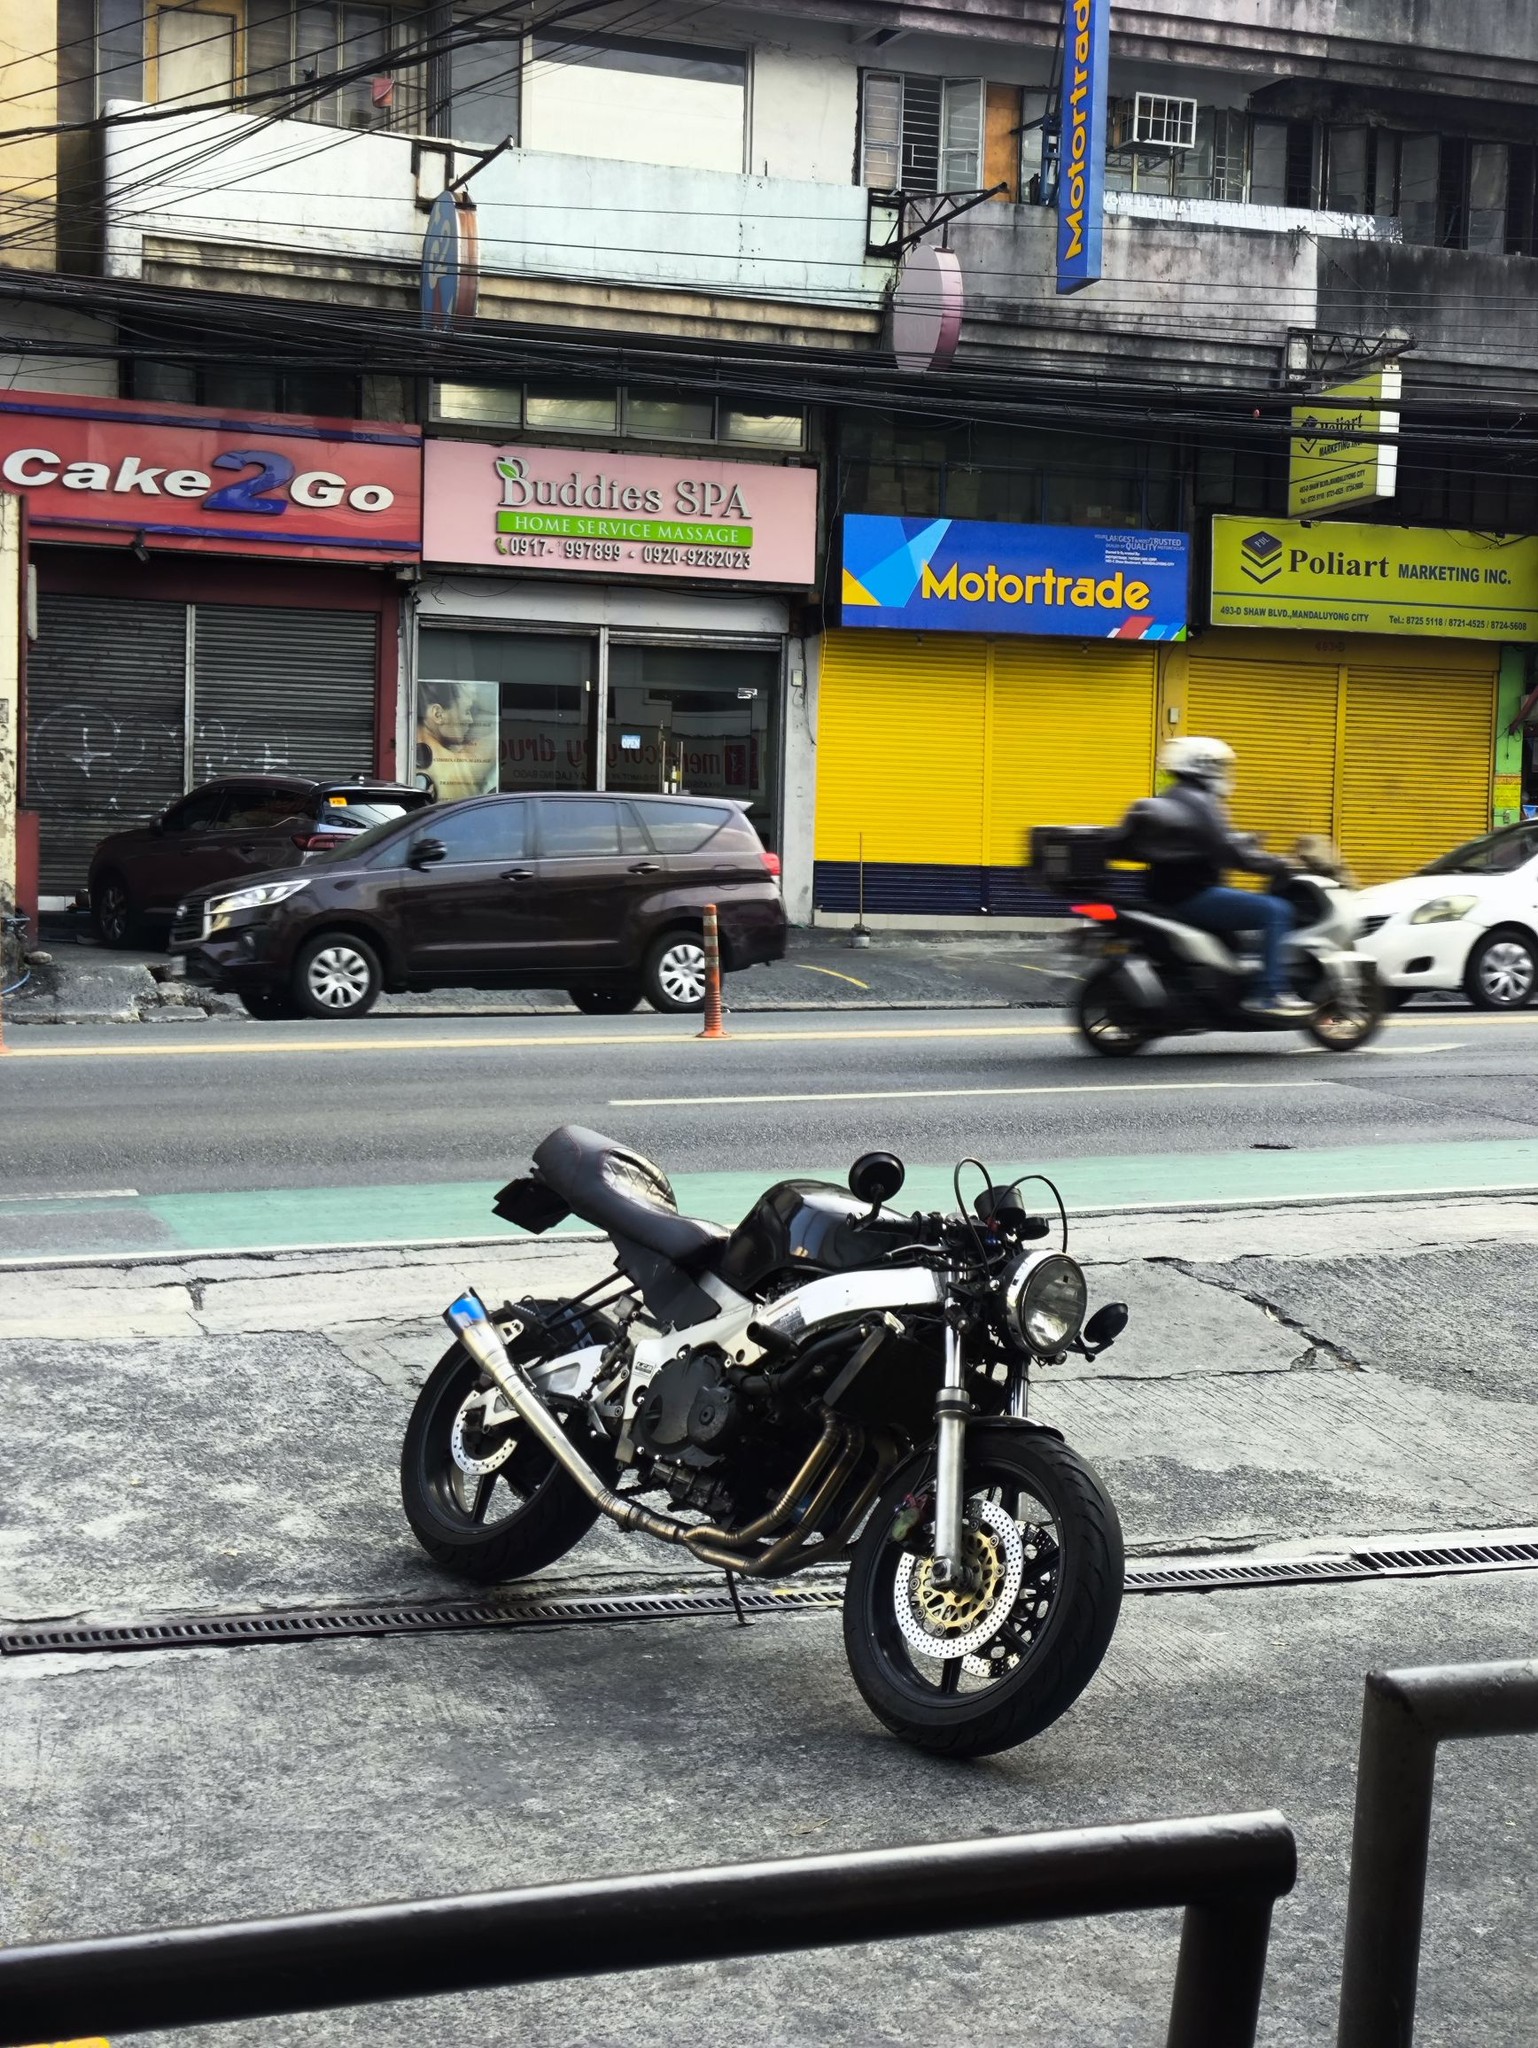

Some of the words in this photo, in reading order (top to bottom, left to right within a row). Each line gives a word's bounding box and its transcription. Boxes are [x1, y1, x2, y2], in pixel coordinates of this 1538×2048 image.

[2, 448, 395, 517] Cake2Go
[496, 455, 664, 515] Buddies
[675, 480, 753, 519] SPA
[515, 516, 571, 534] HOME
[577, 519, 652, 539] SERVICE
[657, 523, 740, 544] MASSAGE
[642, 545, 753, 570] 0920-9282023
[1289, 549, 1390, 579] Poliart
[1398, 563, 1480, 584] MARKETING
[1484, 568, 1512, 585] INC.
[921, 560, 1151, 611] Motortrade
[1220, 606, 1242, 616] 493-D
[1243, 607, 1266, 617] SHAW
[1351, 613, 1370, 622] CITY
[1406, 616, 1424, 626] 8725
